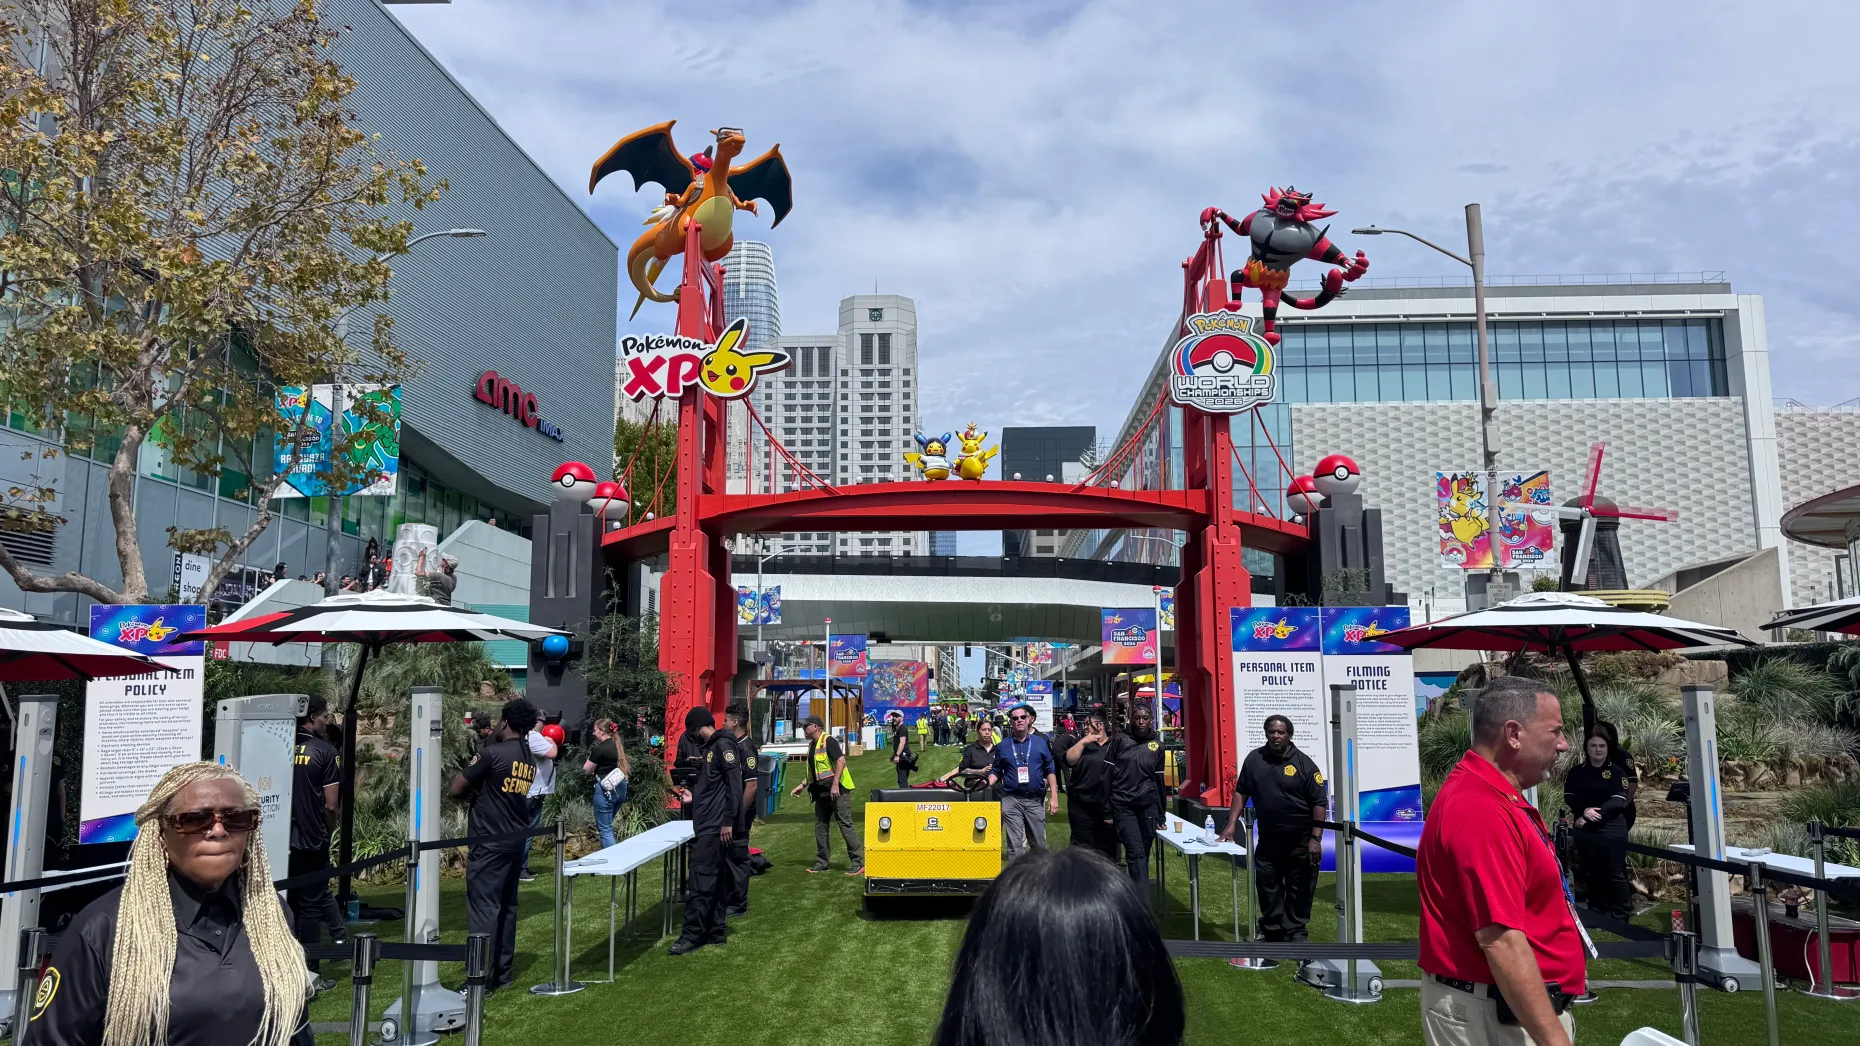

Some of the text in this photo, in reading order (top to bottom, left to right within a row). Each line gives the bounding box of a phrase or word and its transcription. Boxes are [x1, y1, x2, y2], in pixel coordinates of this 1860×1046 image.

[621, 335, 708, 356] Pokémon
[623, 353, 702, 397] XP
[1177, 375, 1270, 389] WORLD
[1179, 389, 1269, 397] CHAMPIONSHIPS
[473, 370, 565, 442] amc IMAX
[1204, 397, 1244, 405] 2026
[184, 560, 201, 573] dine
[119, 628, 148, 641] XP
[1253, 626, 1275, 639] XP
[1344, 630, 1367, 642] XP
[214, 648, 228, 659] FDC
[1240, 662, 1315, 673] PERSONAL ITEM
[1346, 666, 1391, 677] FILMING
[1261, 675, 1294, 686] POLICY
[124, 684, 167, 697] POLICY
[258, 794, 280, 804] CURITY
[260, 803, 280, 814] ECTION
